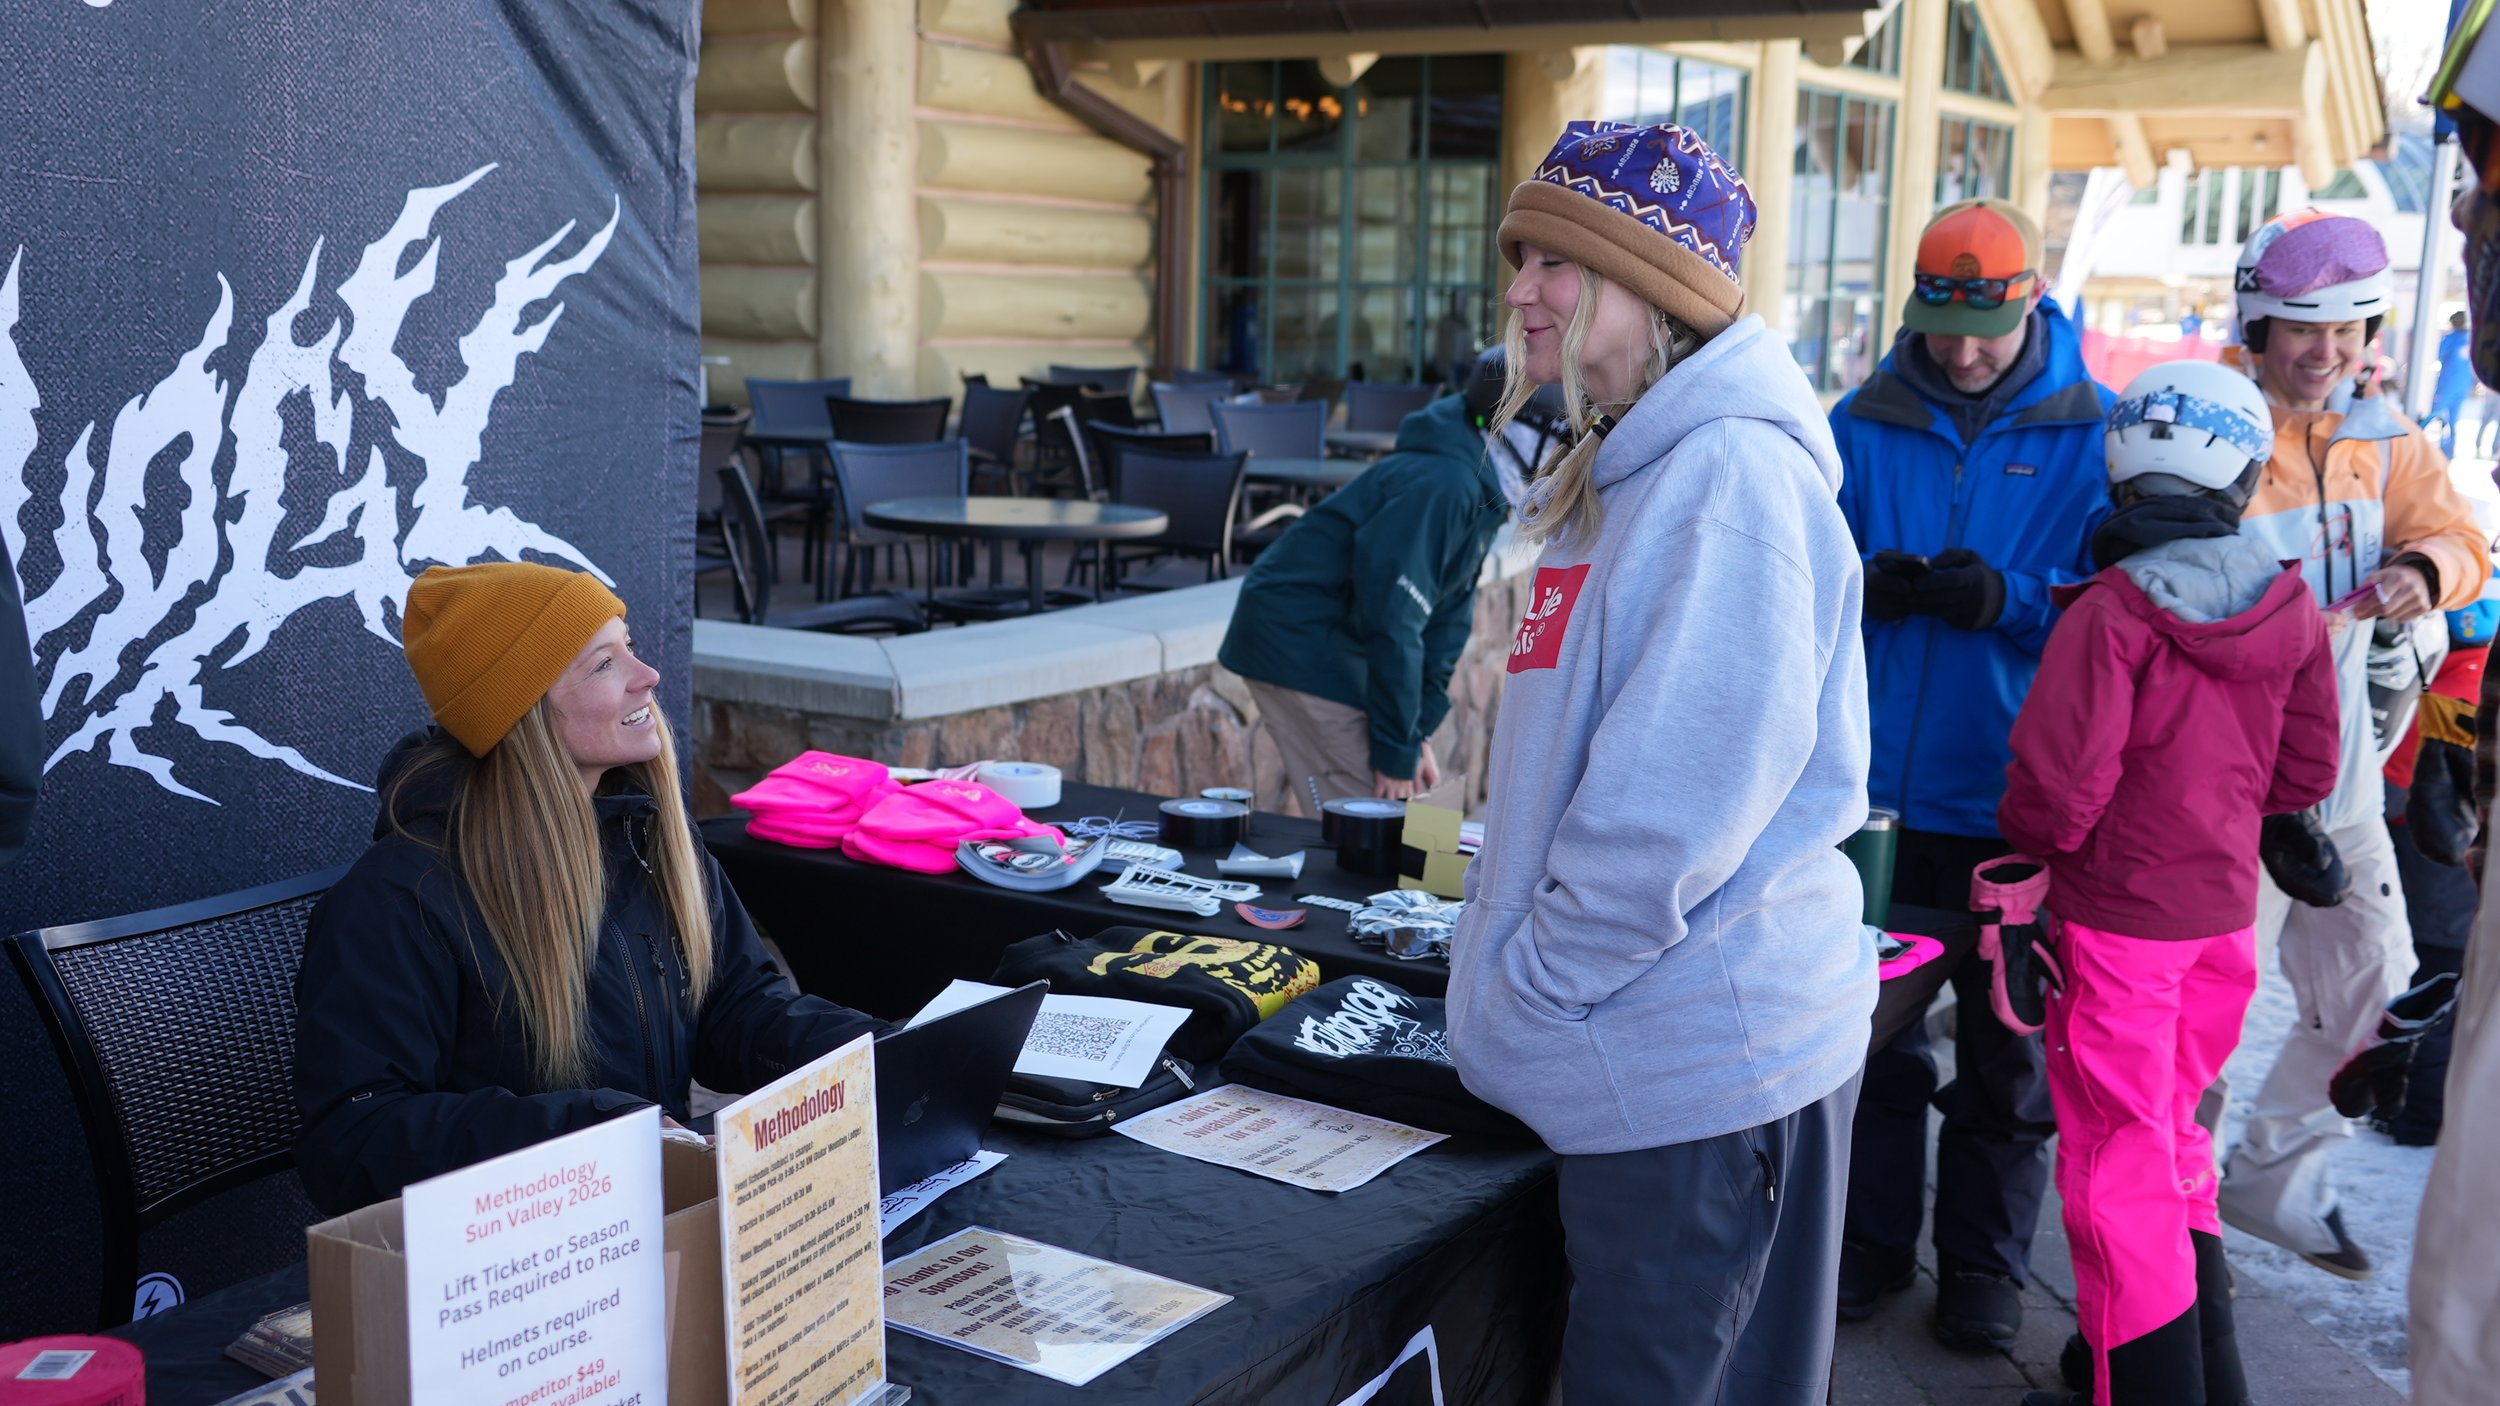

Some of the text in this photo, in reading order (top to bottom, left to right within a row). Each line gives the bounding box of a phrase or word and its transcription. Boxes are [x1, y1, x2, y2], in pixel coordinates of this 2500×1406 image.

[754, 1079, 845, 1152] Methodology
[1165, 1105, 1221, 1126] T-shirts
[1183, 1106, 1262, 1139] Sweatshirts
[1223, 1117, 1277, 1141] for sale
[475, 1160, 597, 1215] Methodology
[466, 1175, 612, 1244] Sun Valley 2026
[863, 1201, 870, 1213] PM
[444, 1219, 629, 1301] Lift Ticket or Season
[889, 1263, 949, 1288] Thanks
[940, 1255, 965, 1265] to
[956, 1244, 988, 1258] Our
[439, 1238, 640, 1329] Pass Required to Race
[918, 1261, 995, 1296] Sponsors!
[943, 1294, 978, 1310] Pabst
[971, 1285, 999, 1297] Blue
[960, 1303, 992, 1317] Vans
[1003, 1288, 1027, 1296] the
[461, 1287, 620, 1369] Helmets required
[952, 1321, 986, 1337] Arbor
[1019, 1319, 1053, 1335] Slush
[1045, 1312, 1068, 1322] the
[1074, 1311, 1100, 1323] Sun
[1080, 1309, 1137, 1336] Sun Valley,
[1117, 1311, 1162, 1330] Effective
[1154, 1300, 1183, 1313] Edge
[498, 1330, 592, 1377] on course.
[504, 1358, 605, 1406] mpetitor $49
